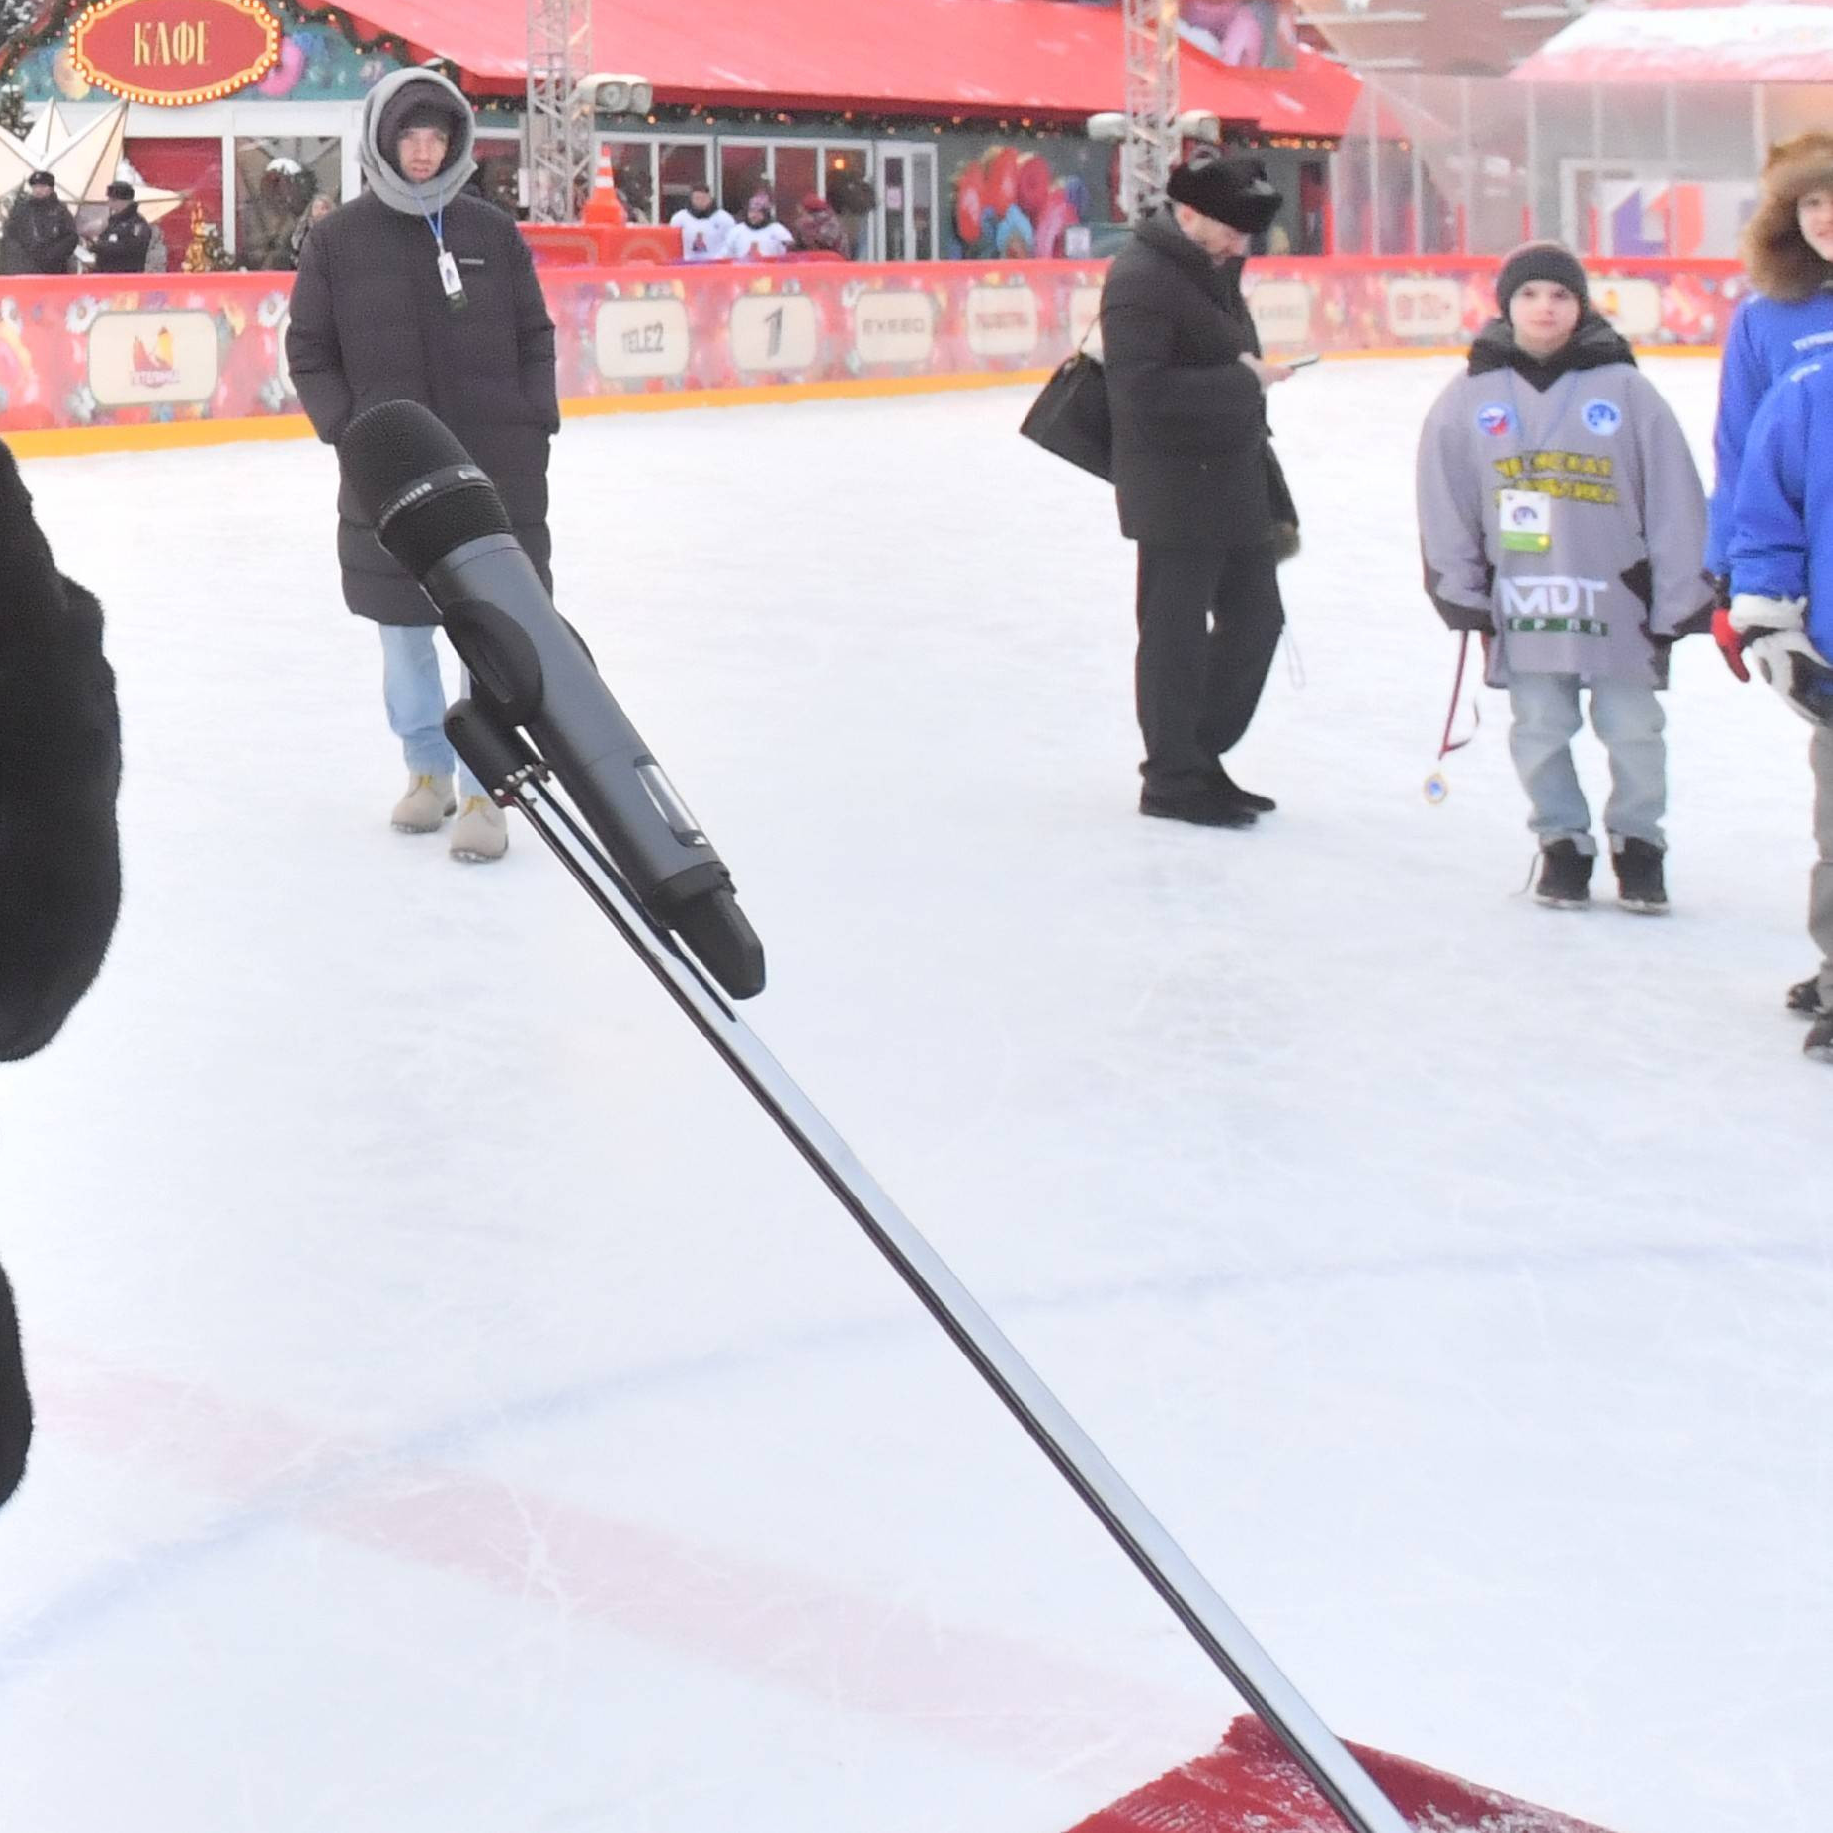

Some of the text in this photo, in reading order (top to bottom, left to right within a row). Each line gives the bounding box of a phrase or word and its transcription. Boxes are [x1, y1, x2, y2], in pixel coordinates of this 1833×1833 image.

[134, 21, 212, 66] КАФЕ
[621, 322, 665, 354] TELE2
[764, 305, 785, 360] 1
